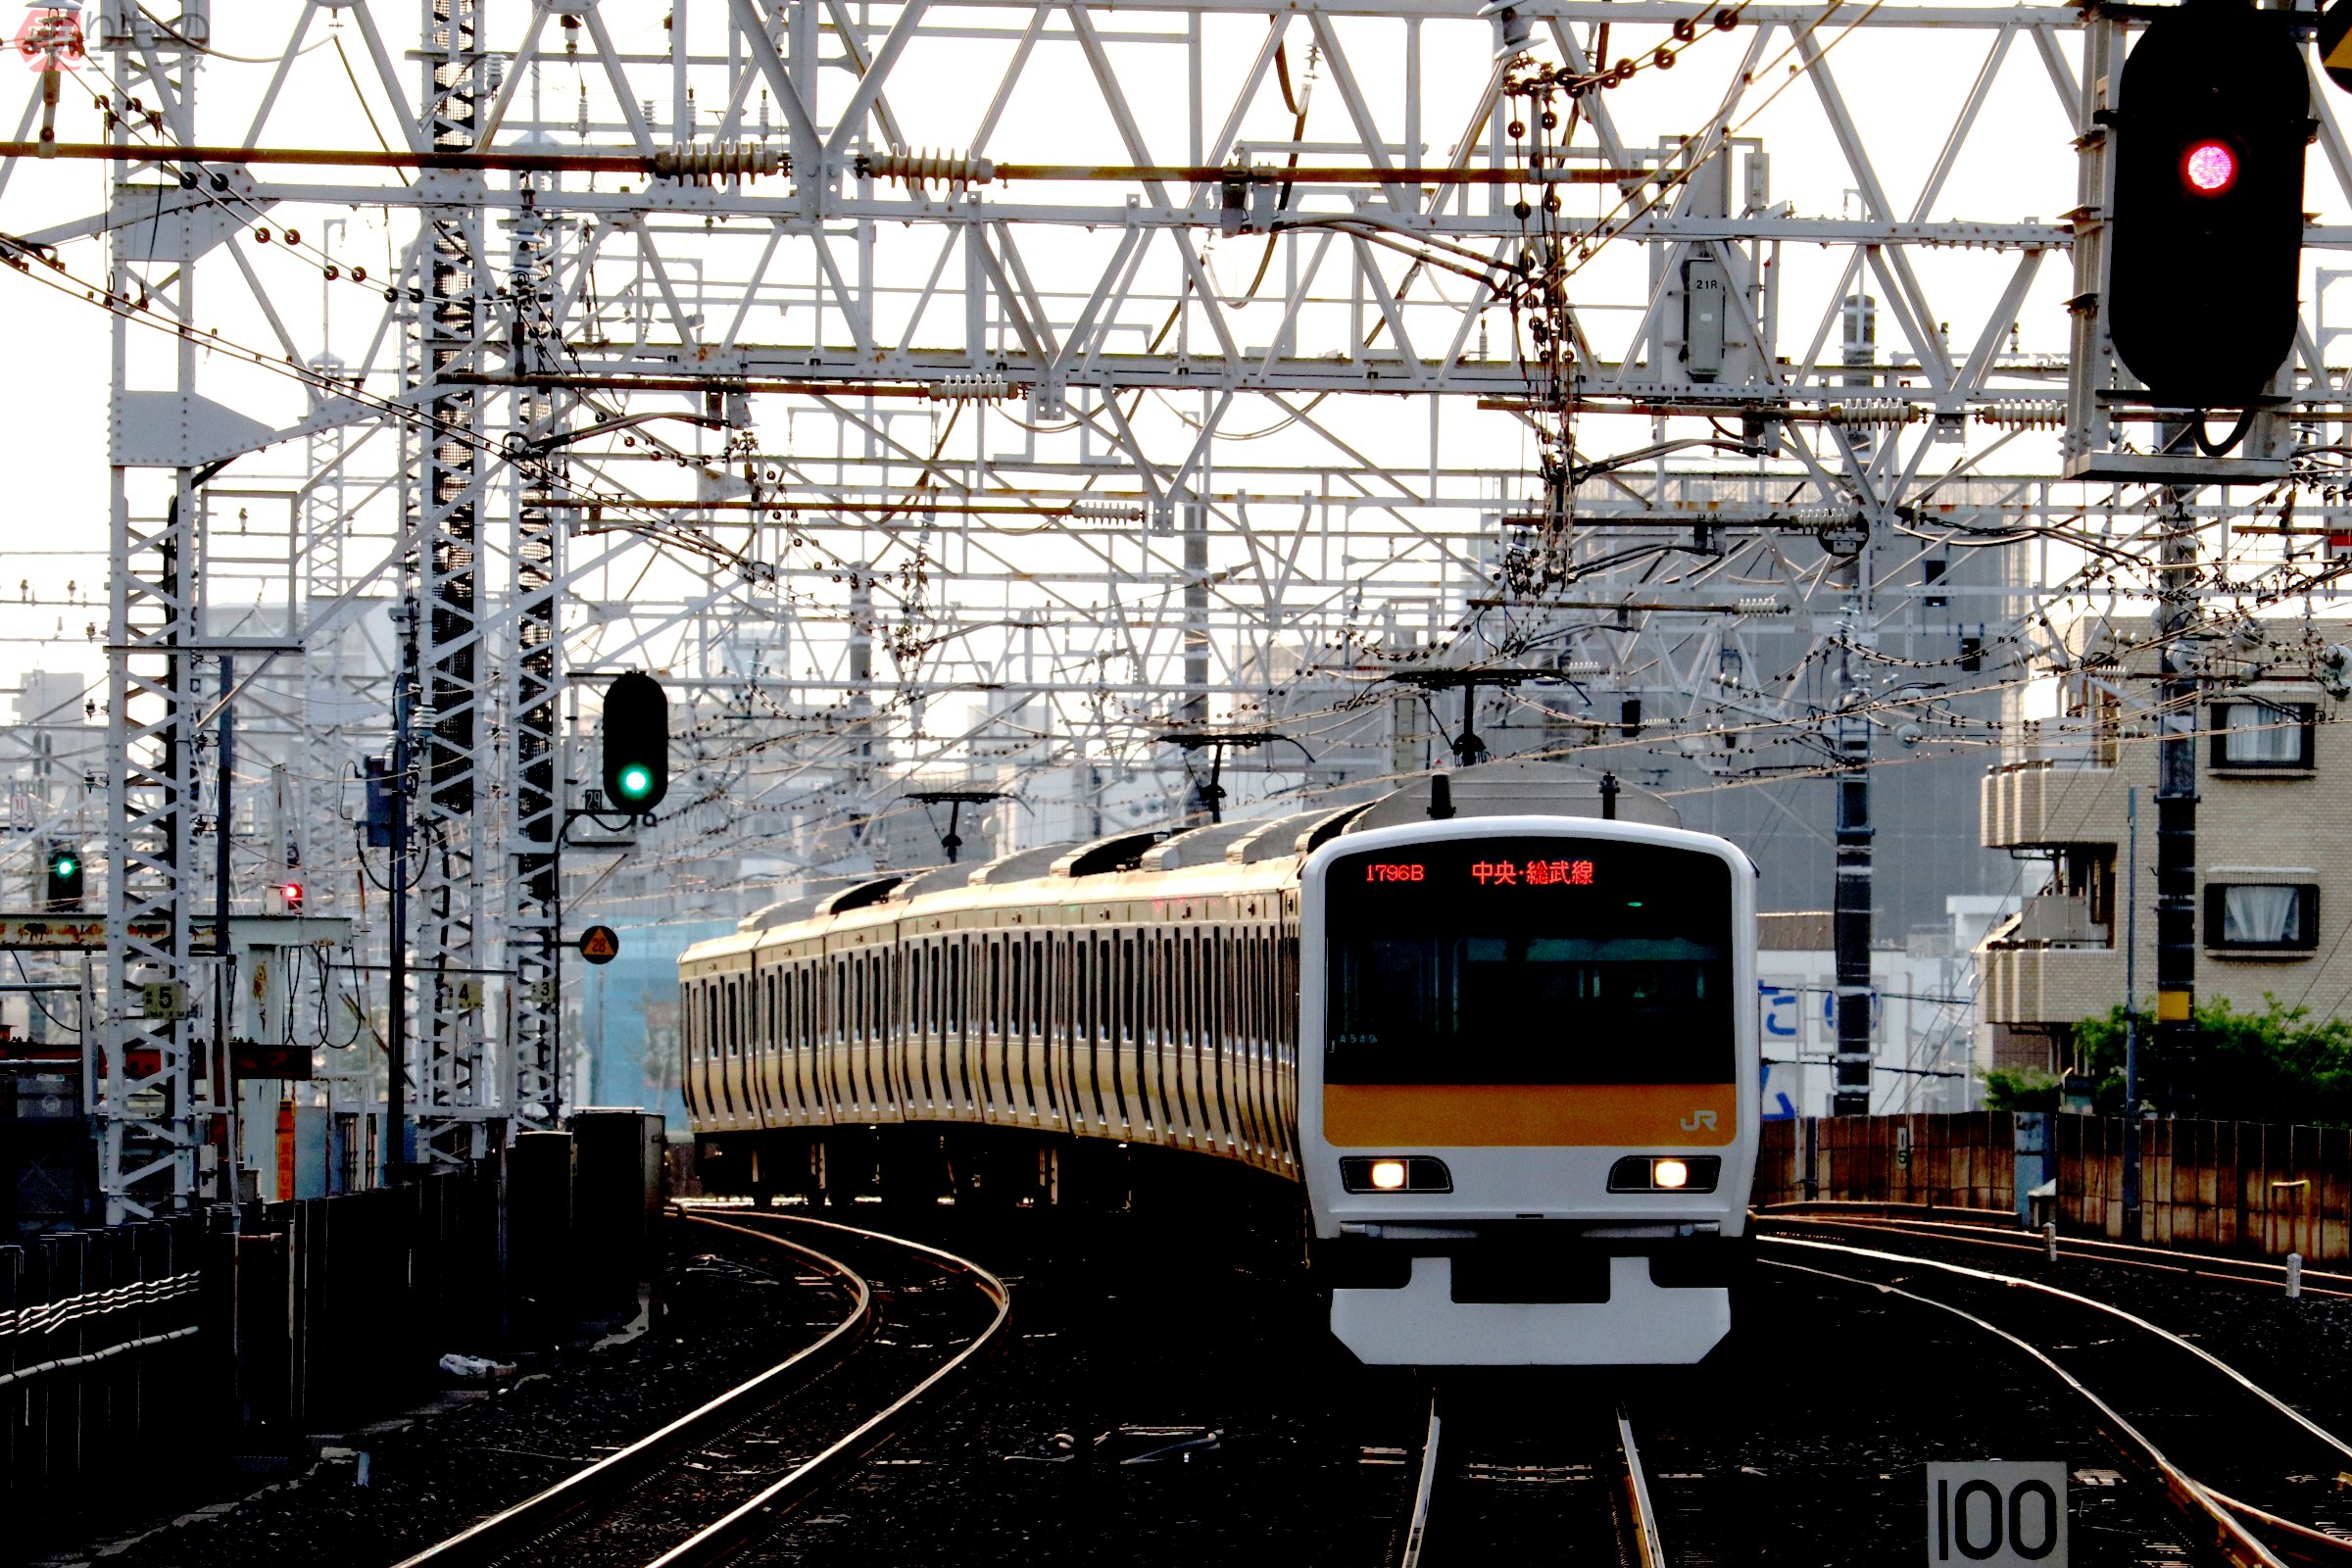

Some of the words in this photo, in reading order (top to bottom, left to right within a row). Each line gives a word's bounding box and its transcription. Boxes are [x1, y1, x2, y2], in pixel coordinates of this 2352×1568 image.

[1696, 279, 1718, 290] 21R
[1366, 864, 1425, 882] 1796B
[592, 938, 606, 953] 28
[1680, 1110, 1717, 1132] JR
[1937, 1479, 2058, 1561] 100
